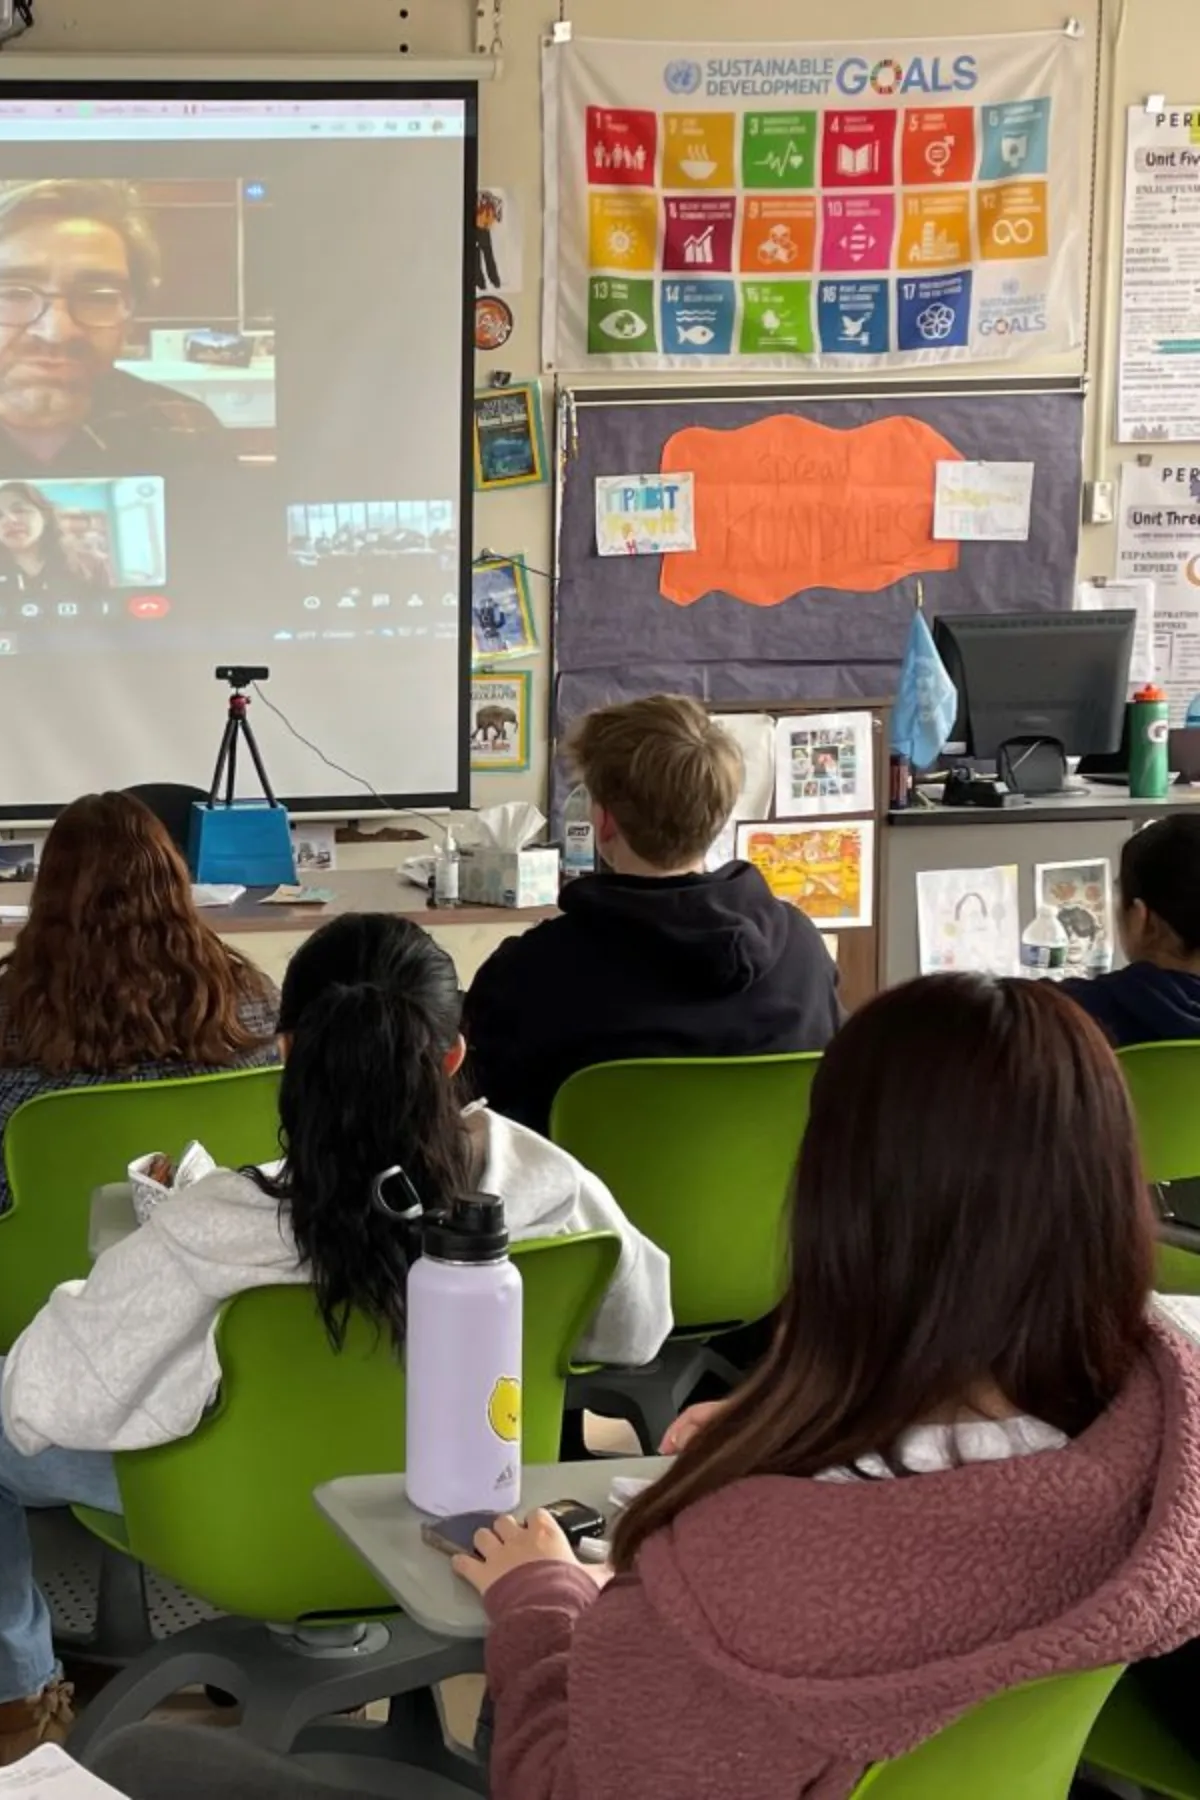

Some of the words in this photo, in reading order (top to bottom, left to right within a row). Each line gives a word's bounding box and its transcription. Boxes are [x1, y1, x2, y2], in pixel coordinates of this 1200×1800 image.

[706, 57, 834, 77] SUSTAINABLE
[835, 54, 979, 95] GOALS
[706, 77, 833, 96] DEVELOPMENT
[750, 117, 759, 136] 3
[830, 116, 840, 133] 4
[908, 113, 919, 132] 5
[988, 110, 999, 126] 6
[1145, 151, 1176, 167] Unit
[827, 201, 843, 216] 10
[593, 282, 609, 300] 13
[665, 285, 679, 303] 14
[822, 285, 837, 303] 16
[903, 283, 916, 300] 17
[978, 314, 1047, 336] GOALS
[1133, 511, 1163, 527] Unit
